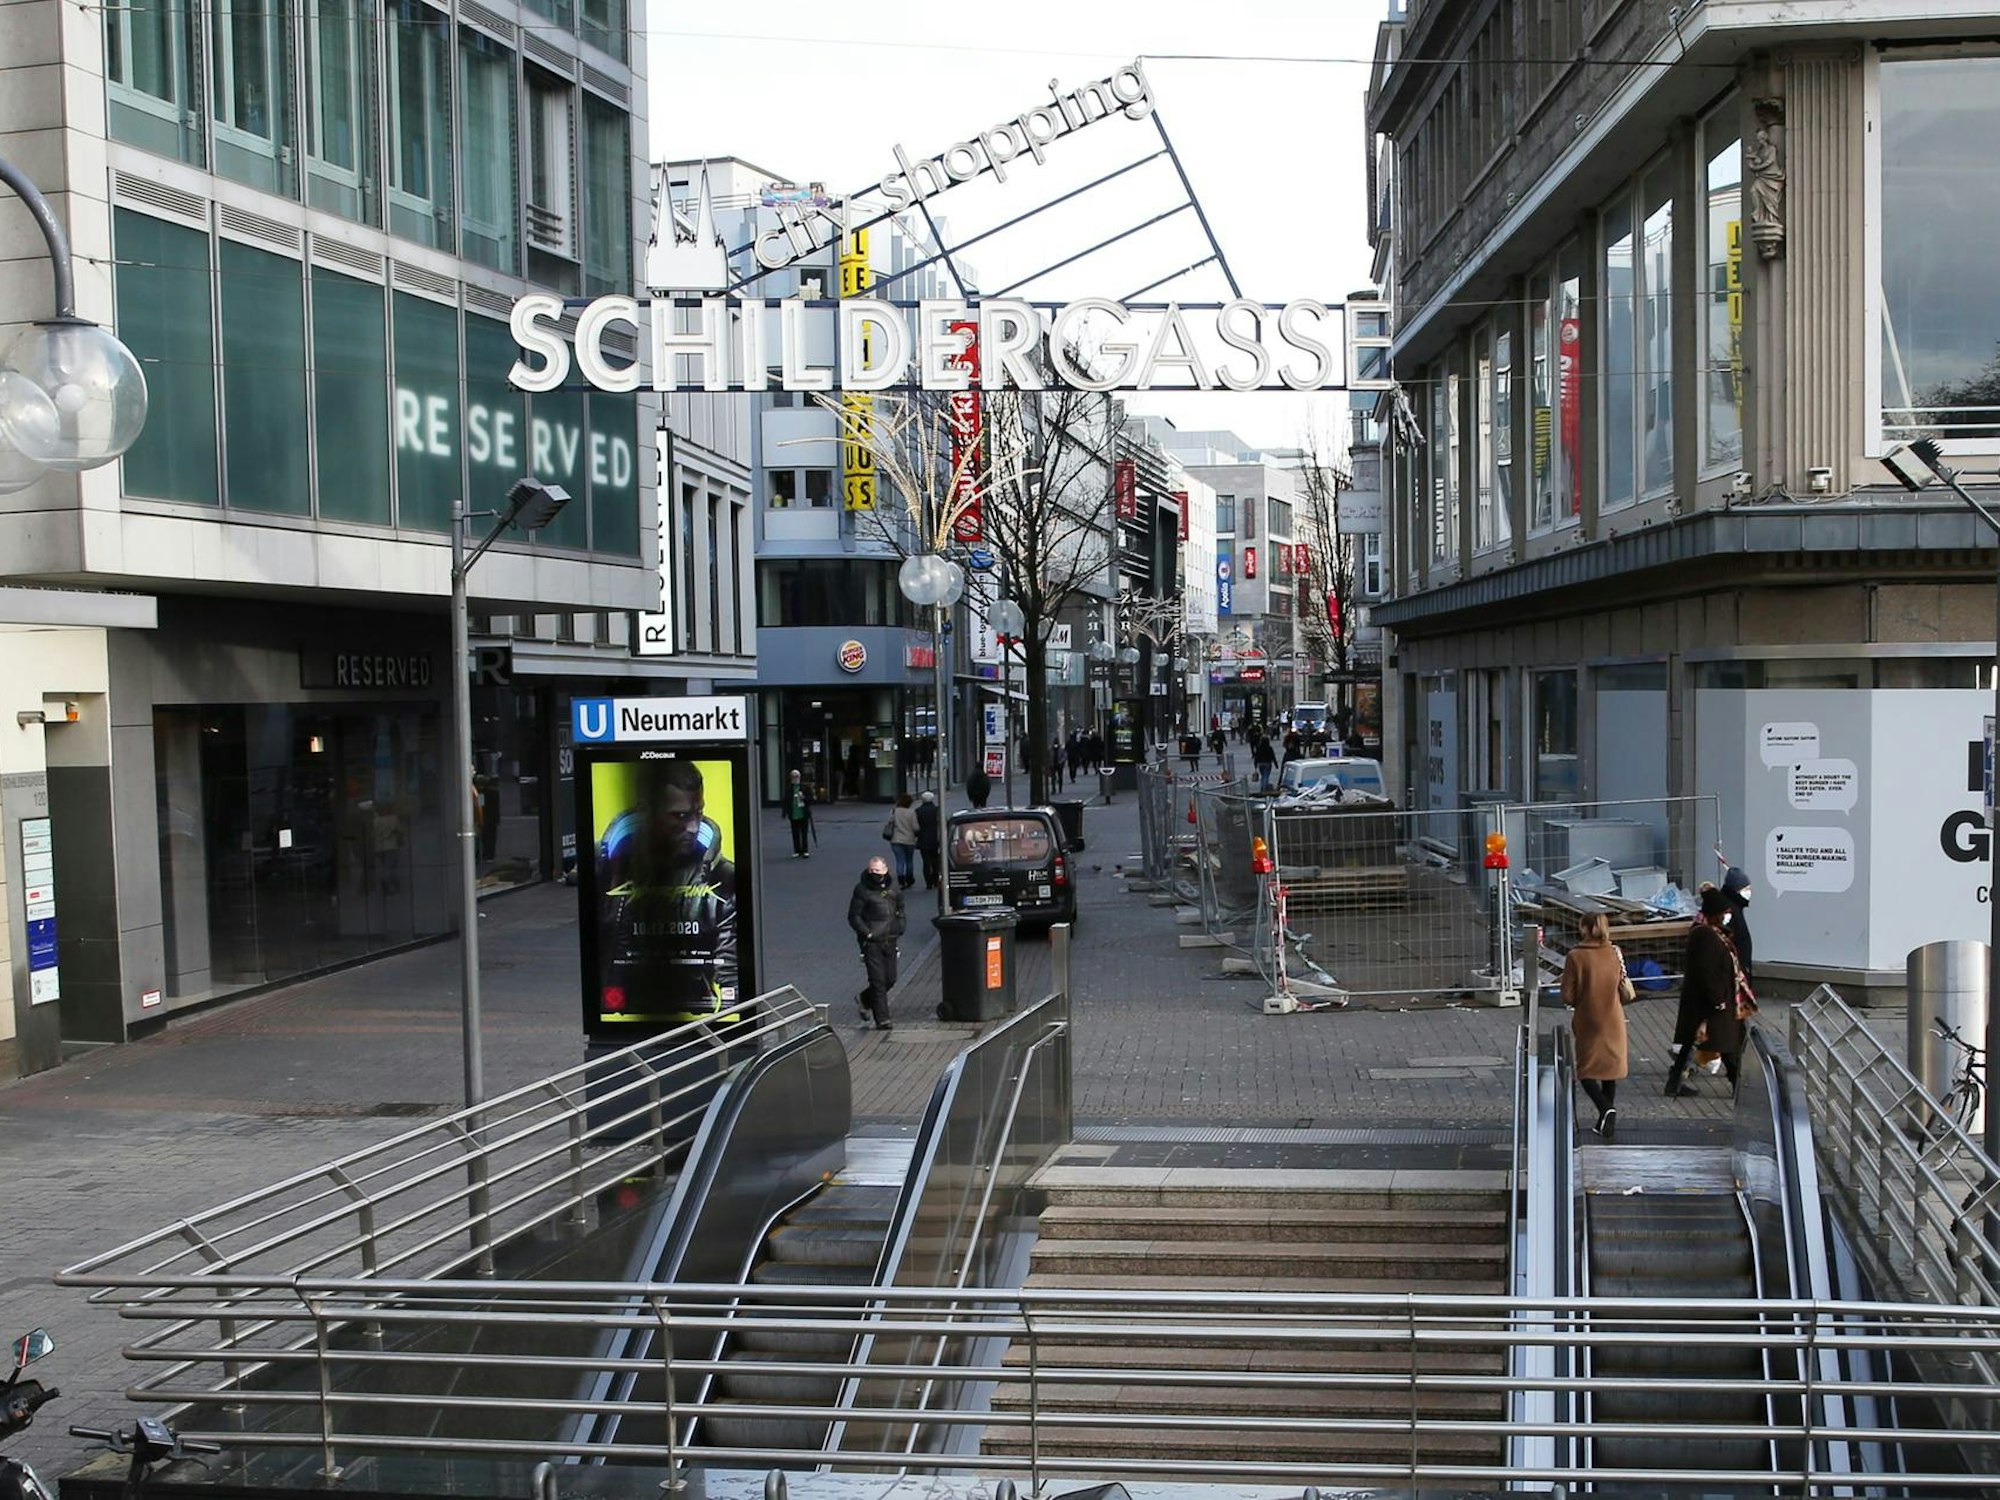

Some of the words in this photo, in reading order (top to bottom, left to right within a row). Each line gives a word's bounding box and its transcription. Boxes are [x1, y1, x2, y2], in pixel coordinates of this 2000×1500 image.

[754, 194, 851, 269] city
[880, 57, 1156, 214] shopping
[508, 296, 1393, 392] SCHILDERGASSE
[336, 654, 431, 686] RESERVED
[843, 652, 864, 664] KING
[621, 706, 740, 732] Neumarkt
